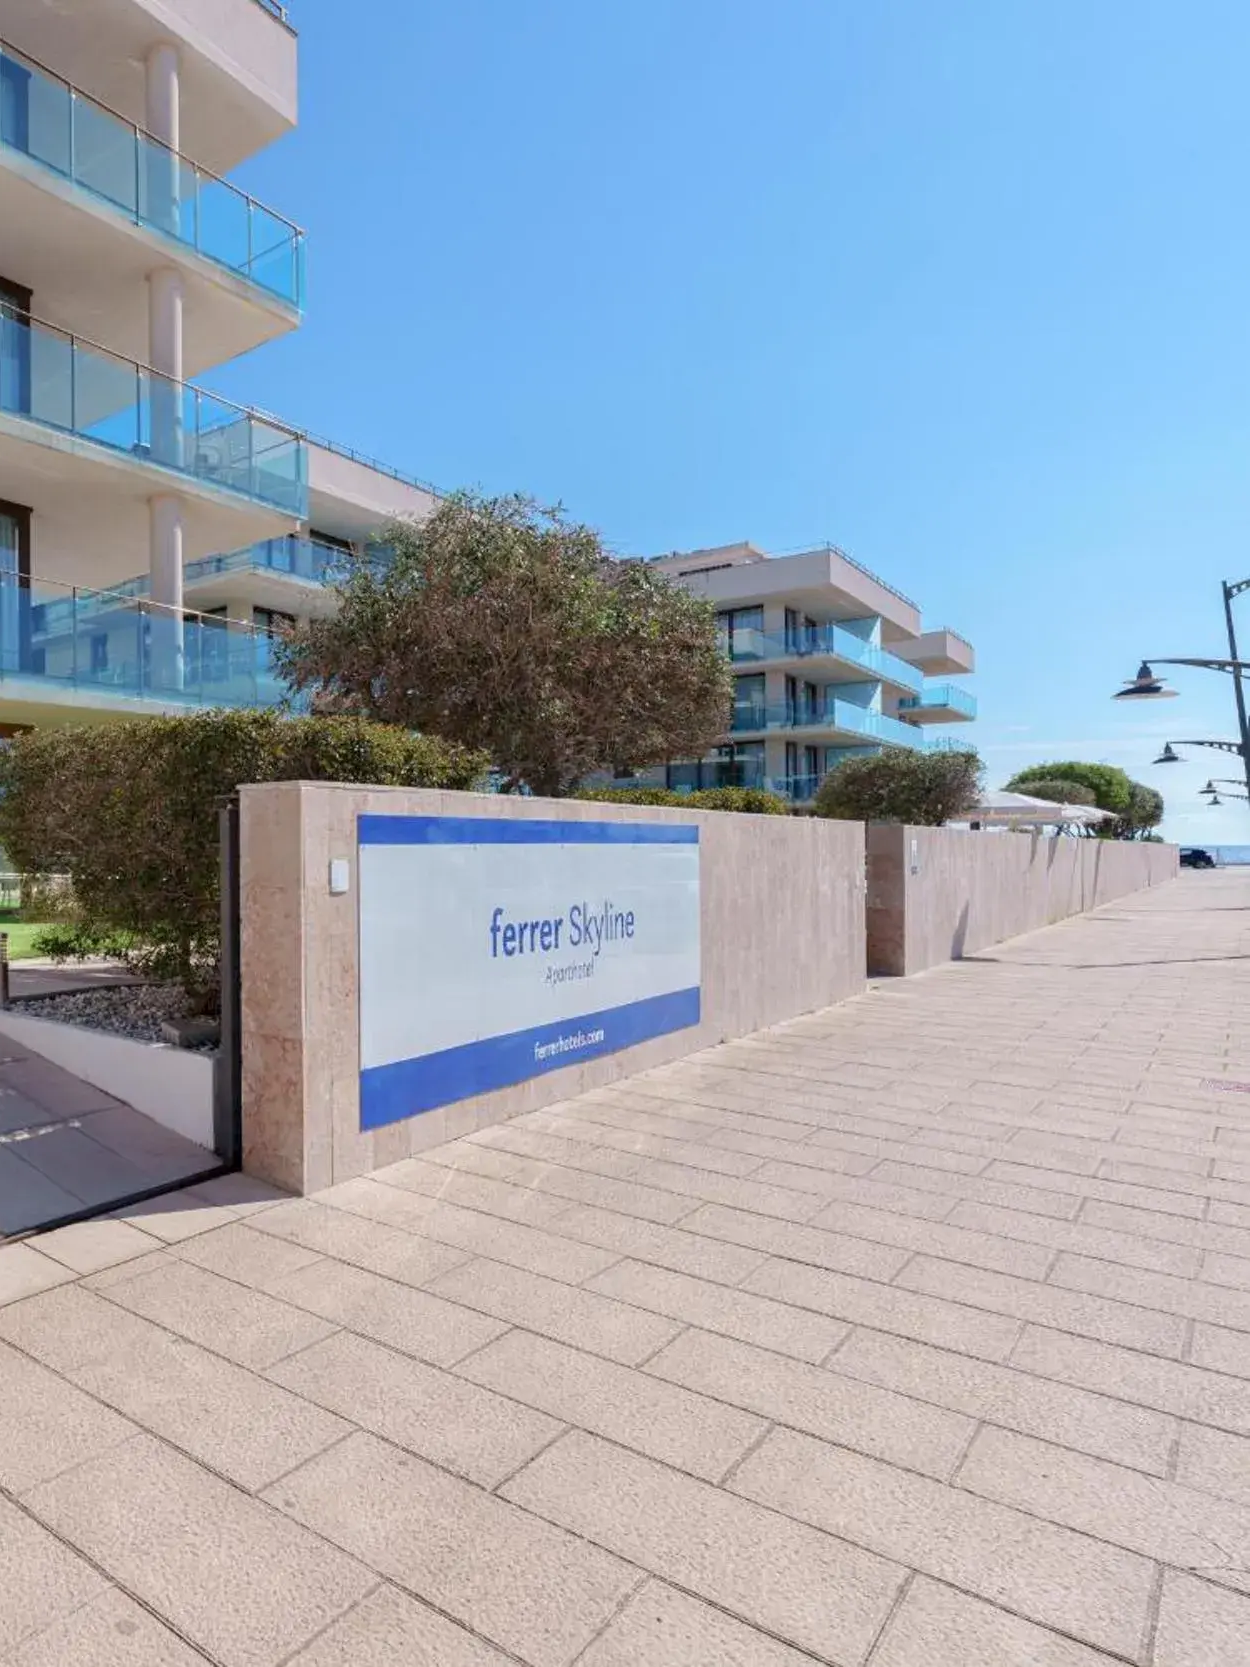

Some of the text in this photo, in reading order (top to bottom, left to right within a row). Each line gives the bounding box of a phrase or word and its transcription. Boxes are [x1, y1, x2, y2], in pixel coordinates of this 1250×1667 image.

[490, 900, 635, 958] ferrer Skyline
[534, 1028, 605, 1061] ferrerhotels.com
